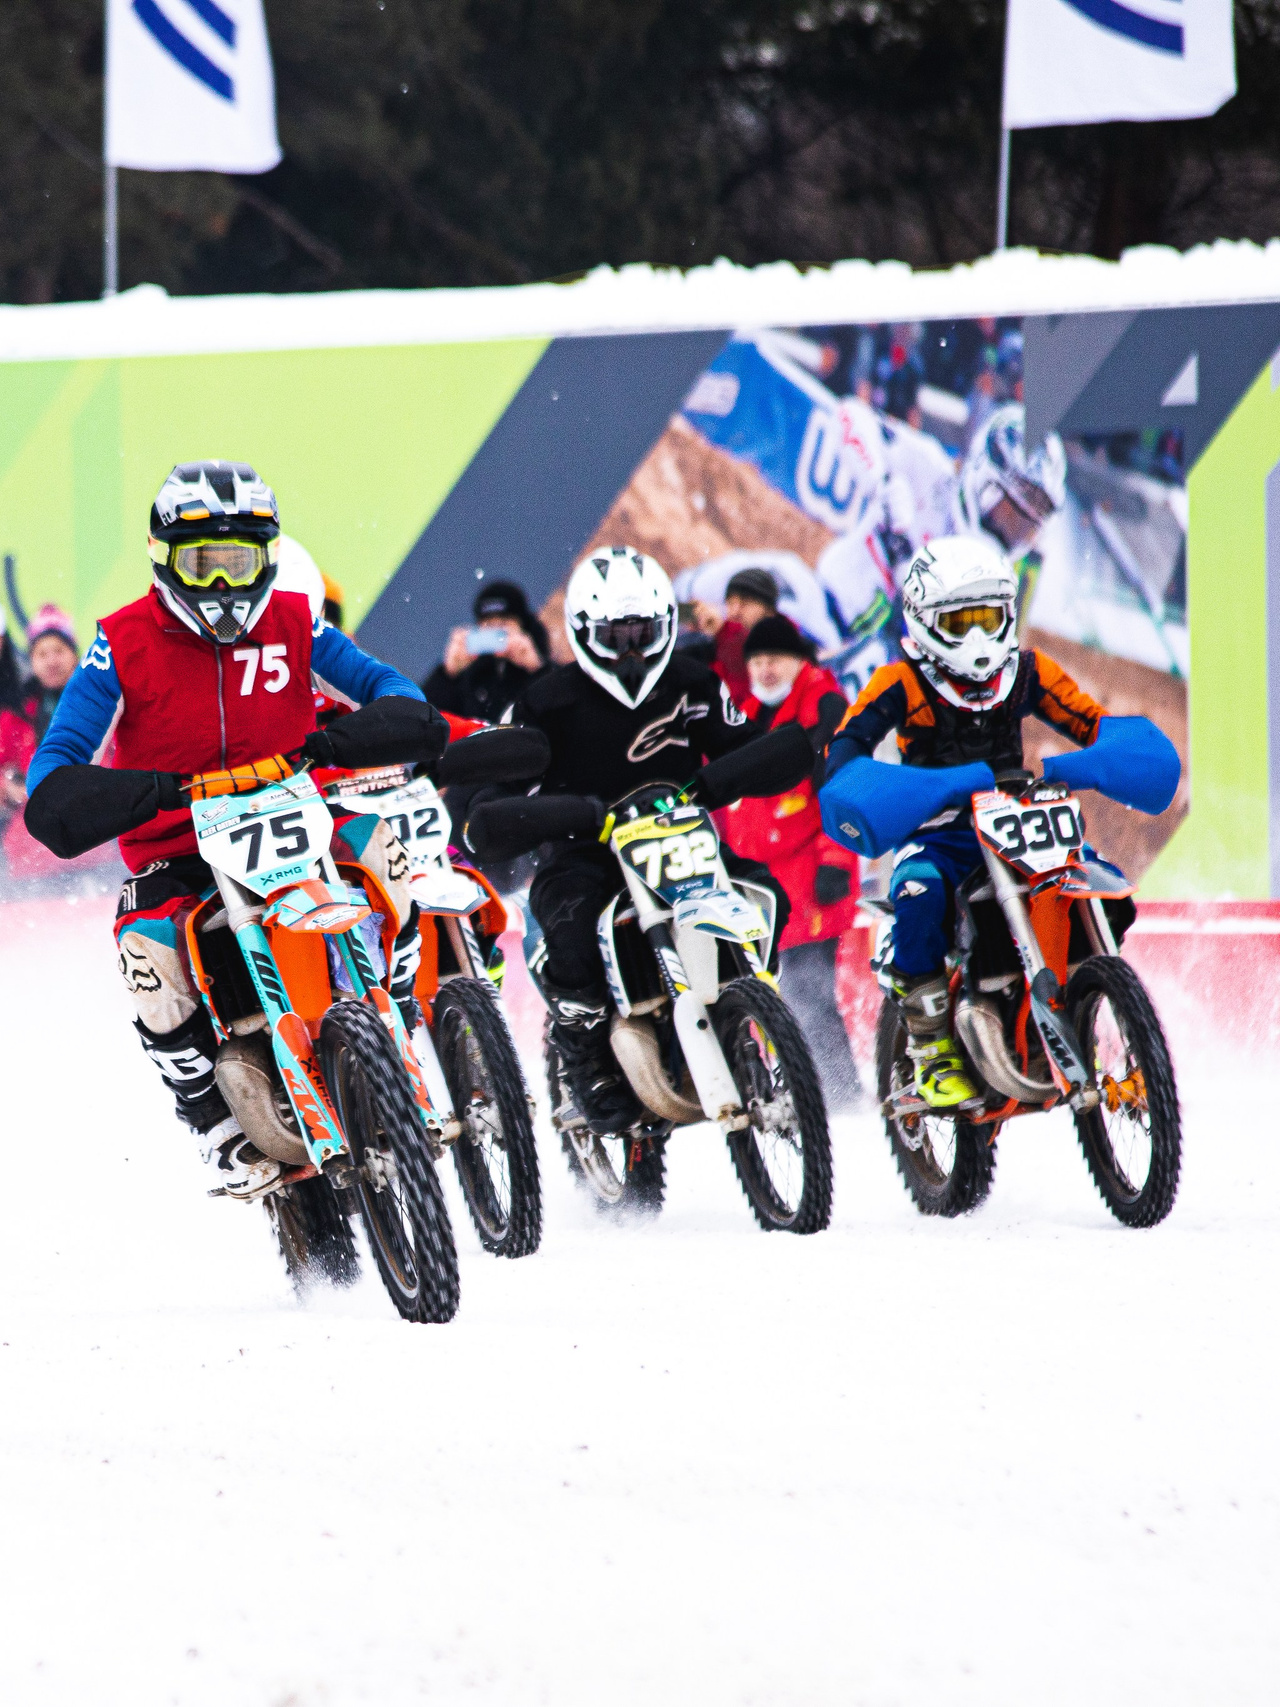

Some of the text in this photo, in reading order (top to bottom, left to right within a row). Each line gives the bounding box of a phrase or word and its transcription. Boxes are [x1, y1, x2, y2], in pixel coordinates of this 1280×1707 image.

[233, 645, 291, 696] 75
[229, 810, 310, 874] 75
[631, 830, 718, 890] 732
[993, 805, 1082, 859] 330
